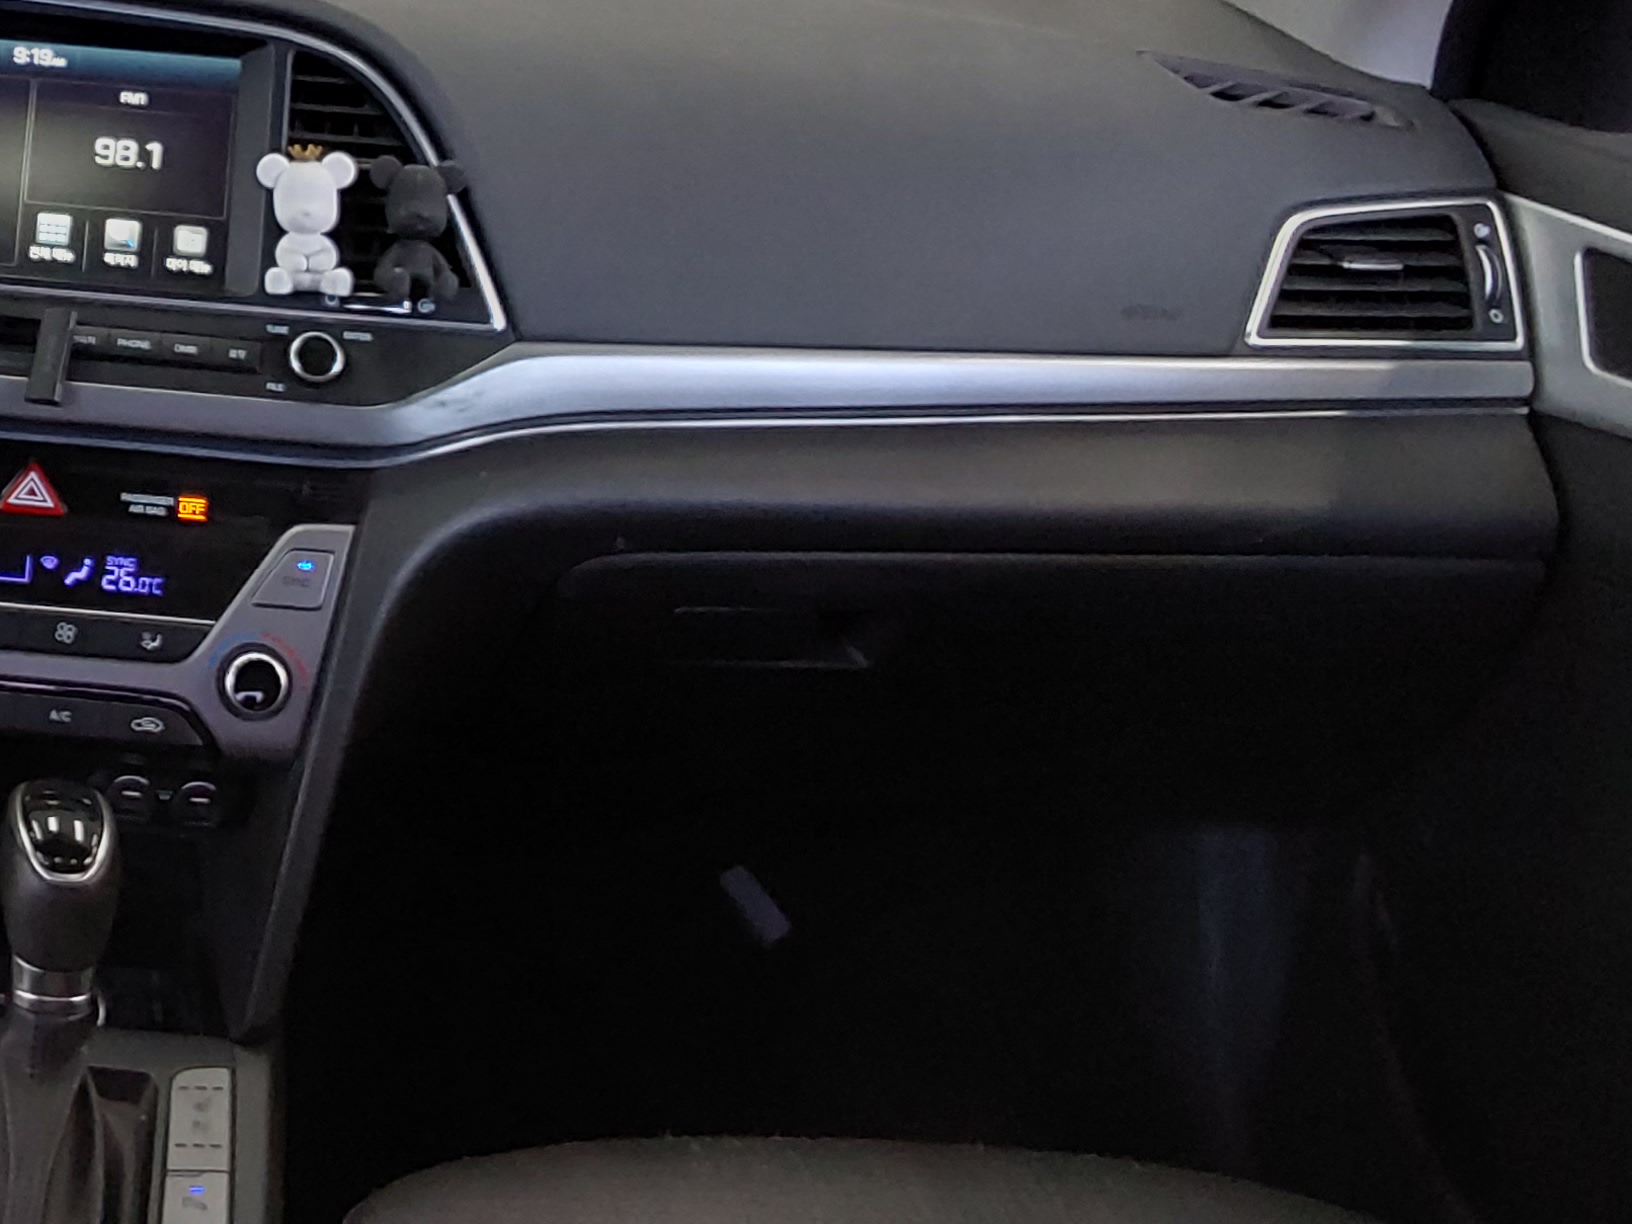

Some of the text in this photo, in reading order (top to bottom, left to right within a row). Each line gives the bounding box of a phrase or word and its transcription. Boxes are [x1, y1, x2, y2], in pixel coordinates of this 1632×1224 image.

[94, 136, 164, 171] 98.1
[117, 337, 153, 350] PHONE
[177, 500, 207, 516] OFF
[106, 556, 137, 568] SYNC
